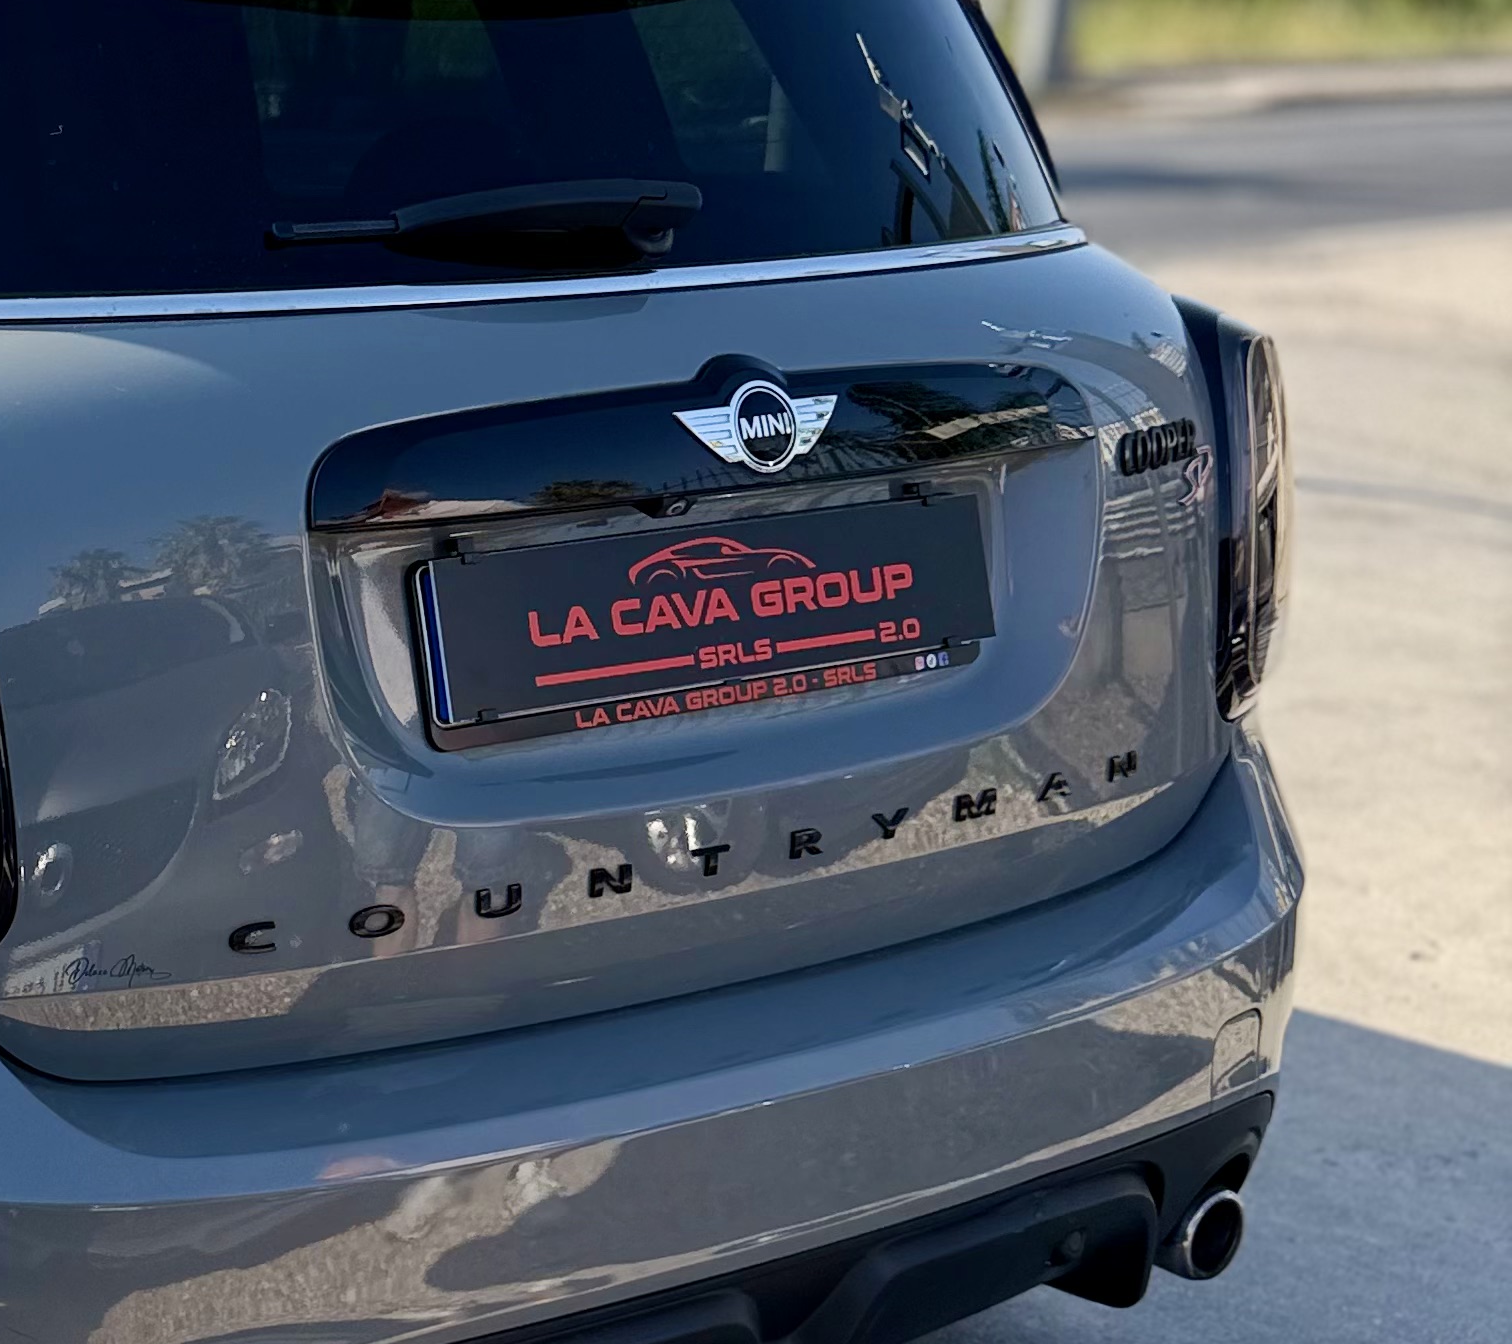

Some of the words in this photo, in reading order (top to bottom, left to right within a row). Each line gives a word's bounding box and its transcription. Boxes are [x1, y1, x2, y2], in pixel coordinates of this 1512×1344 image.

[739, 411, 792, 440] MINI
[1115, 417, 1197, 477] COOPER
[529, 605, 599, 648] LA
[611, 588, 740, 637] CAVA
[751, 564, 914, 618] GROUP
[698, 639, 772, 669] SRLS
[879, 618, 920, 643] 2.0
[575, 707, 610, 729] LA
[616, 697, 680, 722] CAVA
[686, 681, 768, 711] GROUP
[773, 674, 807, 697] 2.0
[824, 662, 877, 688] SRLS
[228, 750, 1138, 954] COUNTRYMAN
